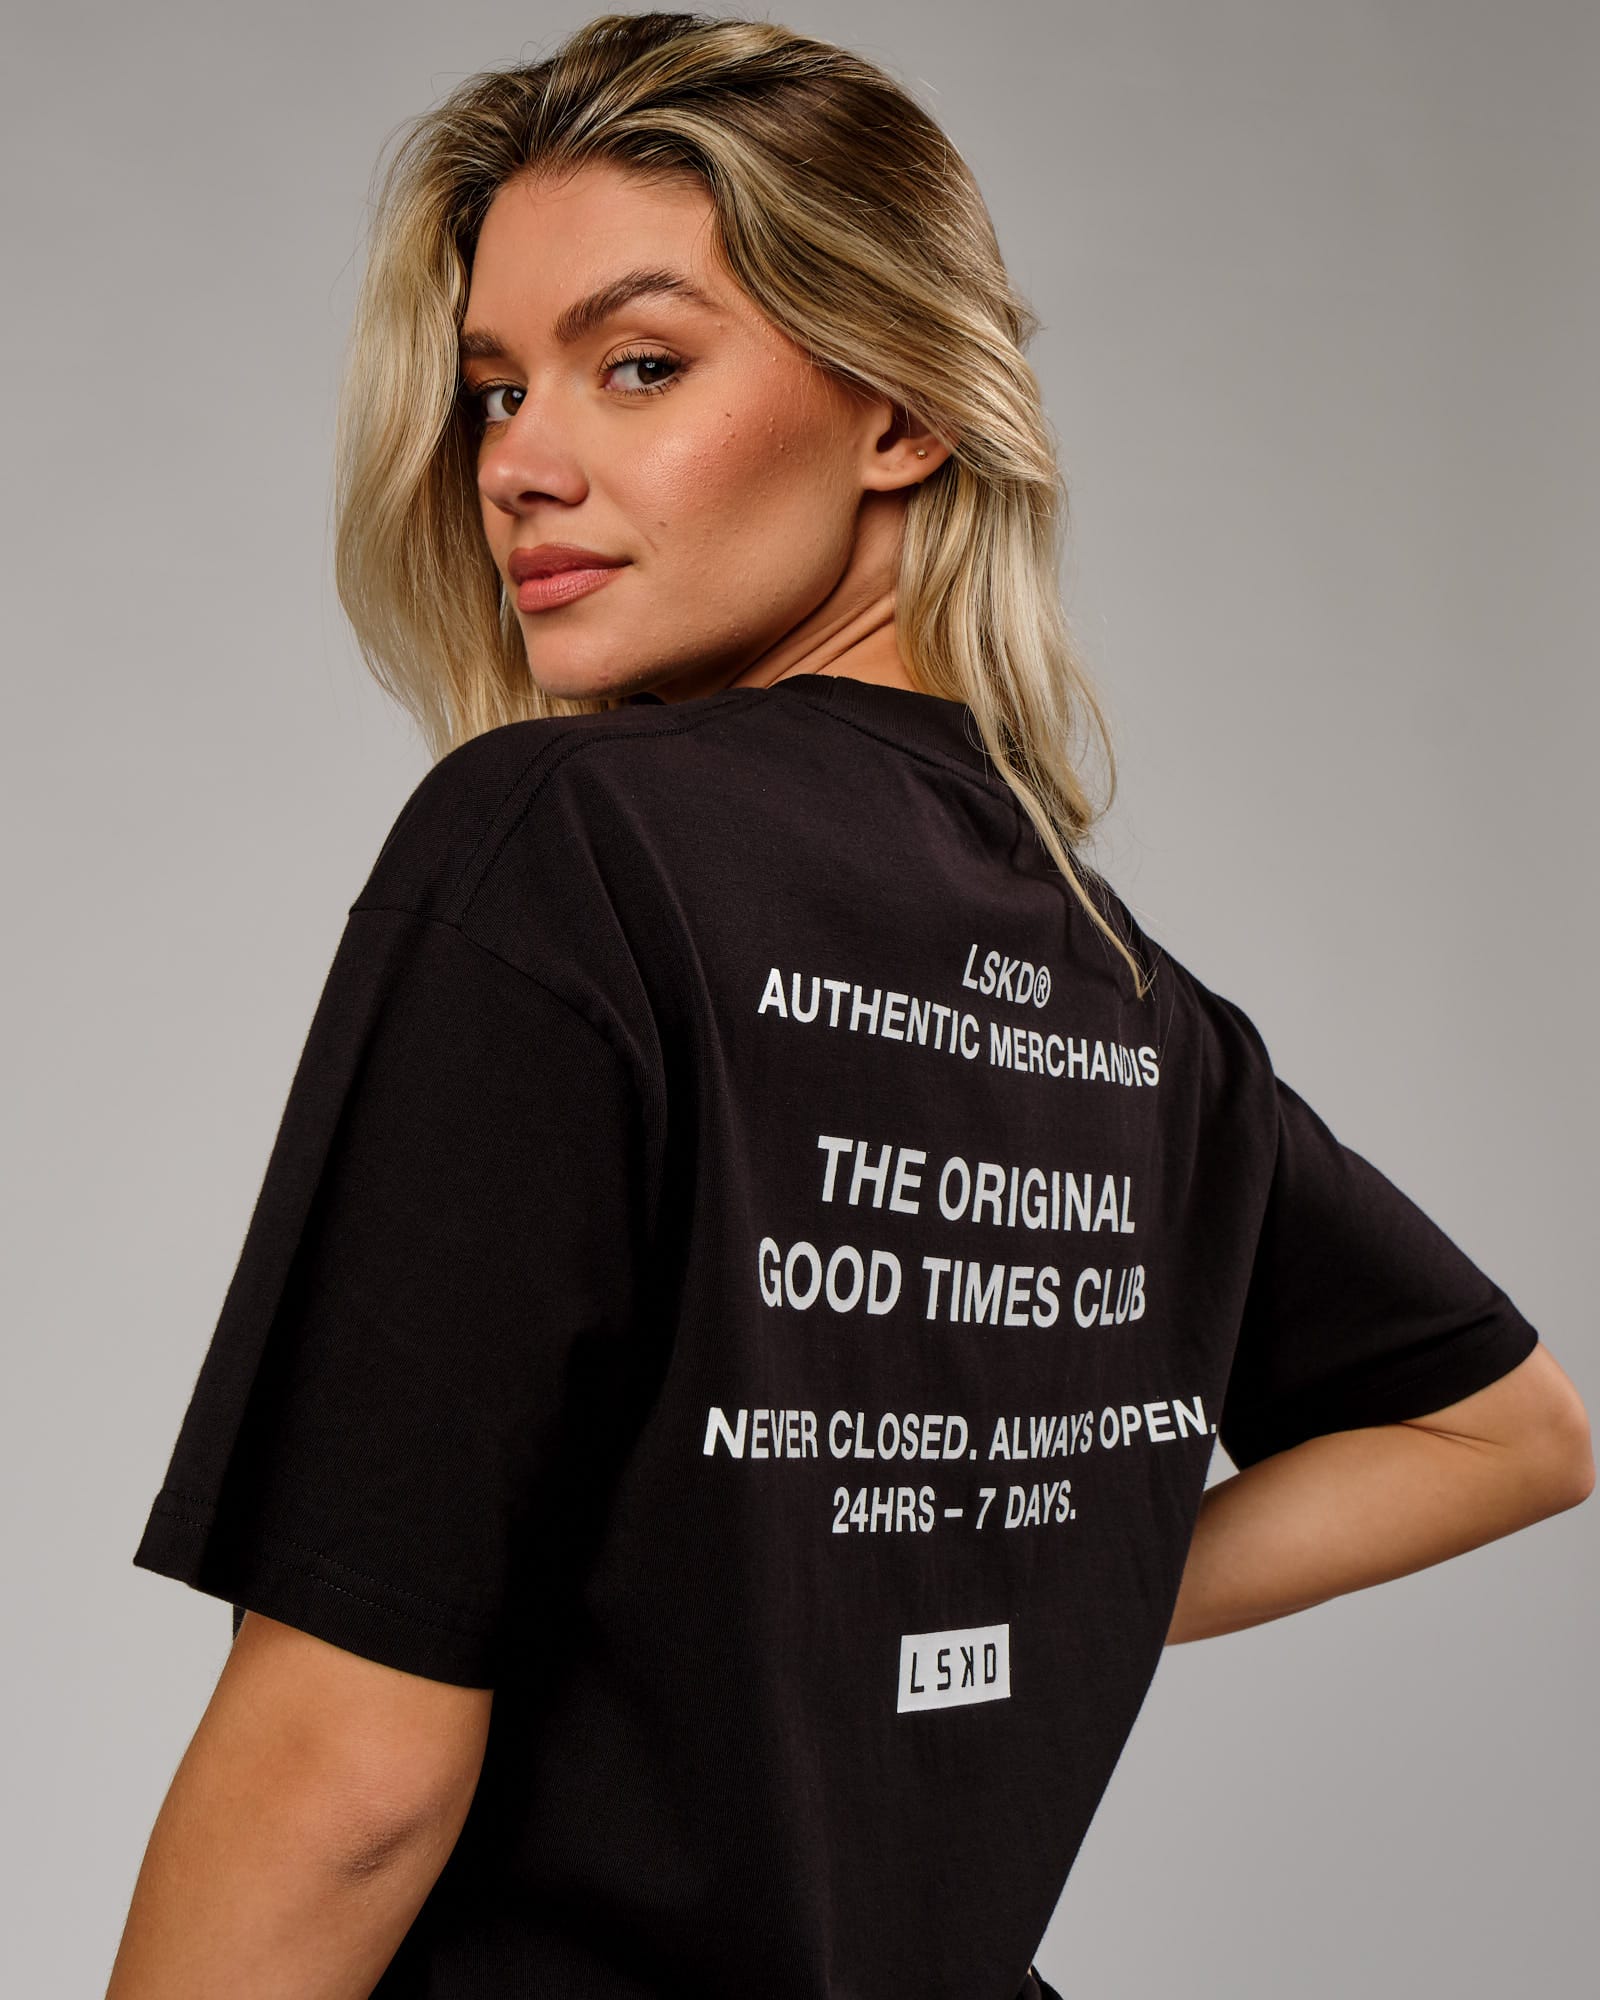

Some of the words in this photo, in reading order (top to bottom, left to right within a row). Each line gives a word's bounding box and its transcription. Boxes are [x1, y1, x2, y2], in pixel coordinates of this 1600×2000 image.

[757, 967, 980, 1060] AUTHENTIC
[817, 1135, 928, 1215] THE
[938, 1156, 1136, 1234] ORIGINAL
[758, 1236, 902, 1316] GOOD
[922, 1256, 1061, 1328] TIMES
[1073, 1264, 1146, 1329] CLUB
[702, 1406, 819, 1459] NEVER
[828, 1410, 977, 1461] CLOSED.
[988, 1410, 1094, 1461] ALWAYS
[1099, 1395, 1217, 1449] OPEN.
[831, 1486, 936, 1534] 24HRS
[975, 1487, 997, 1530] 7
[1004, 1479, 1076, 1529] DAYS.
